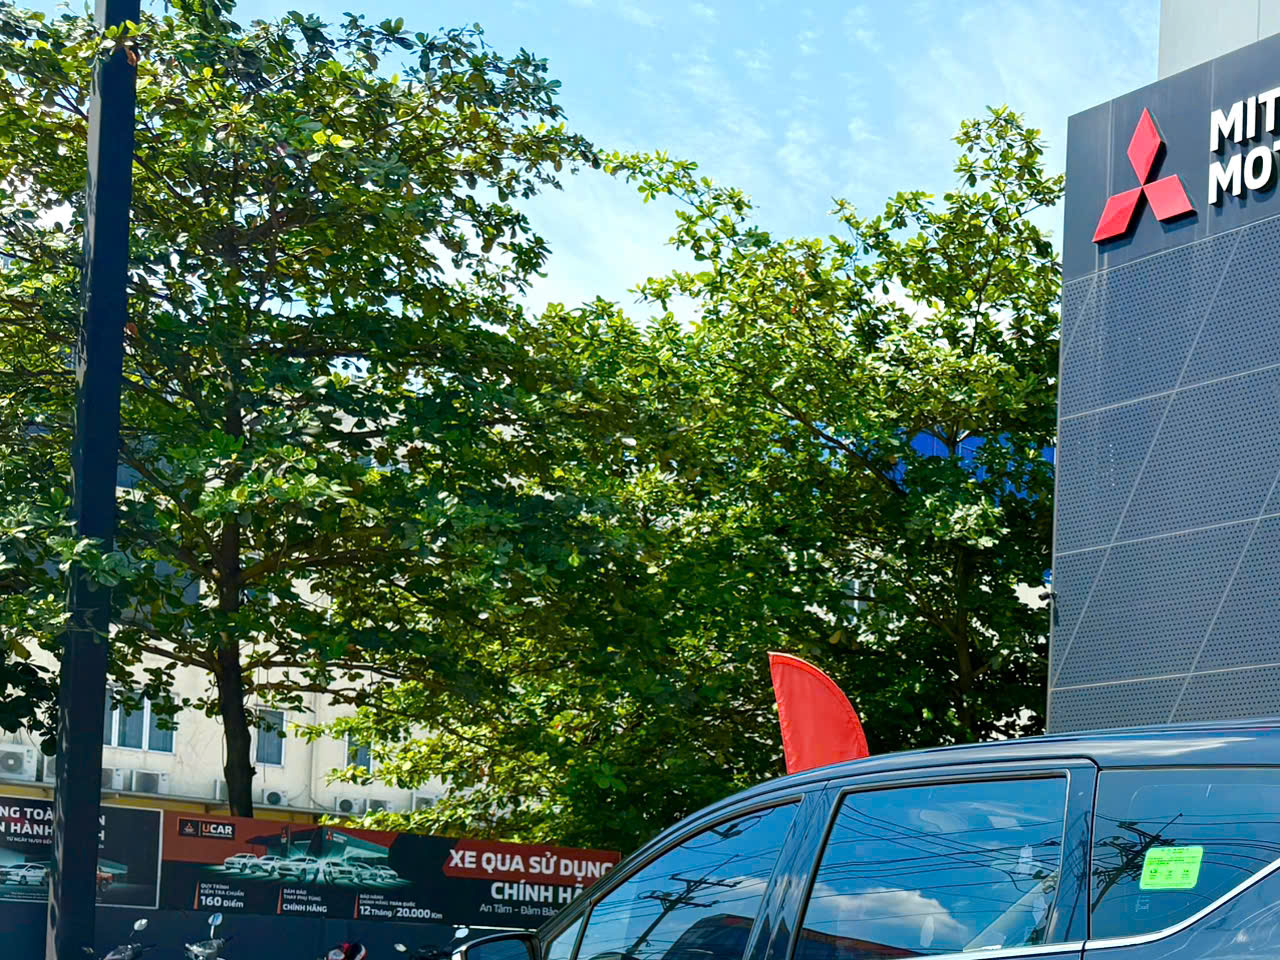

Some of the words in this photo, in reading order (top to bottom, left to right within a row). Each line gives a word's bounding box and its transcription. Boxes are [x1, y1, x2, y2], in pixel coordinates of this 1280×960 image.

[202, 823, 233, 834] UCAR
[449, 849, 477, 868] XE
[481, 852, 525, 873] QUA
[529, 852, 557, 875] SỬ
[491, 879, 554, 903] CHÍNH
[200, 896, 222, 906] 160
[282, 902, 306, 911] CHÍNH
[306, 903, 328, 913] HÃNG
[479, 903, 493, 913] An
[397, 908, 431, 919] 20.000
